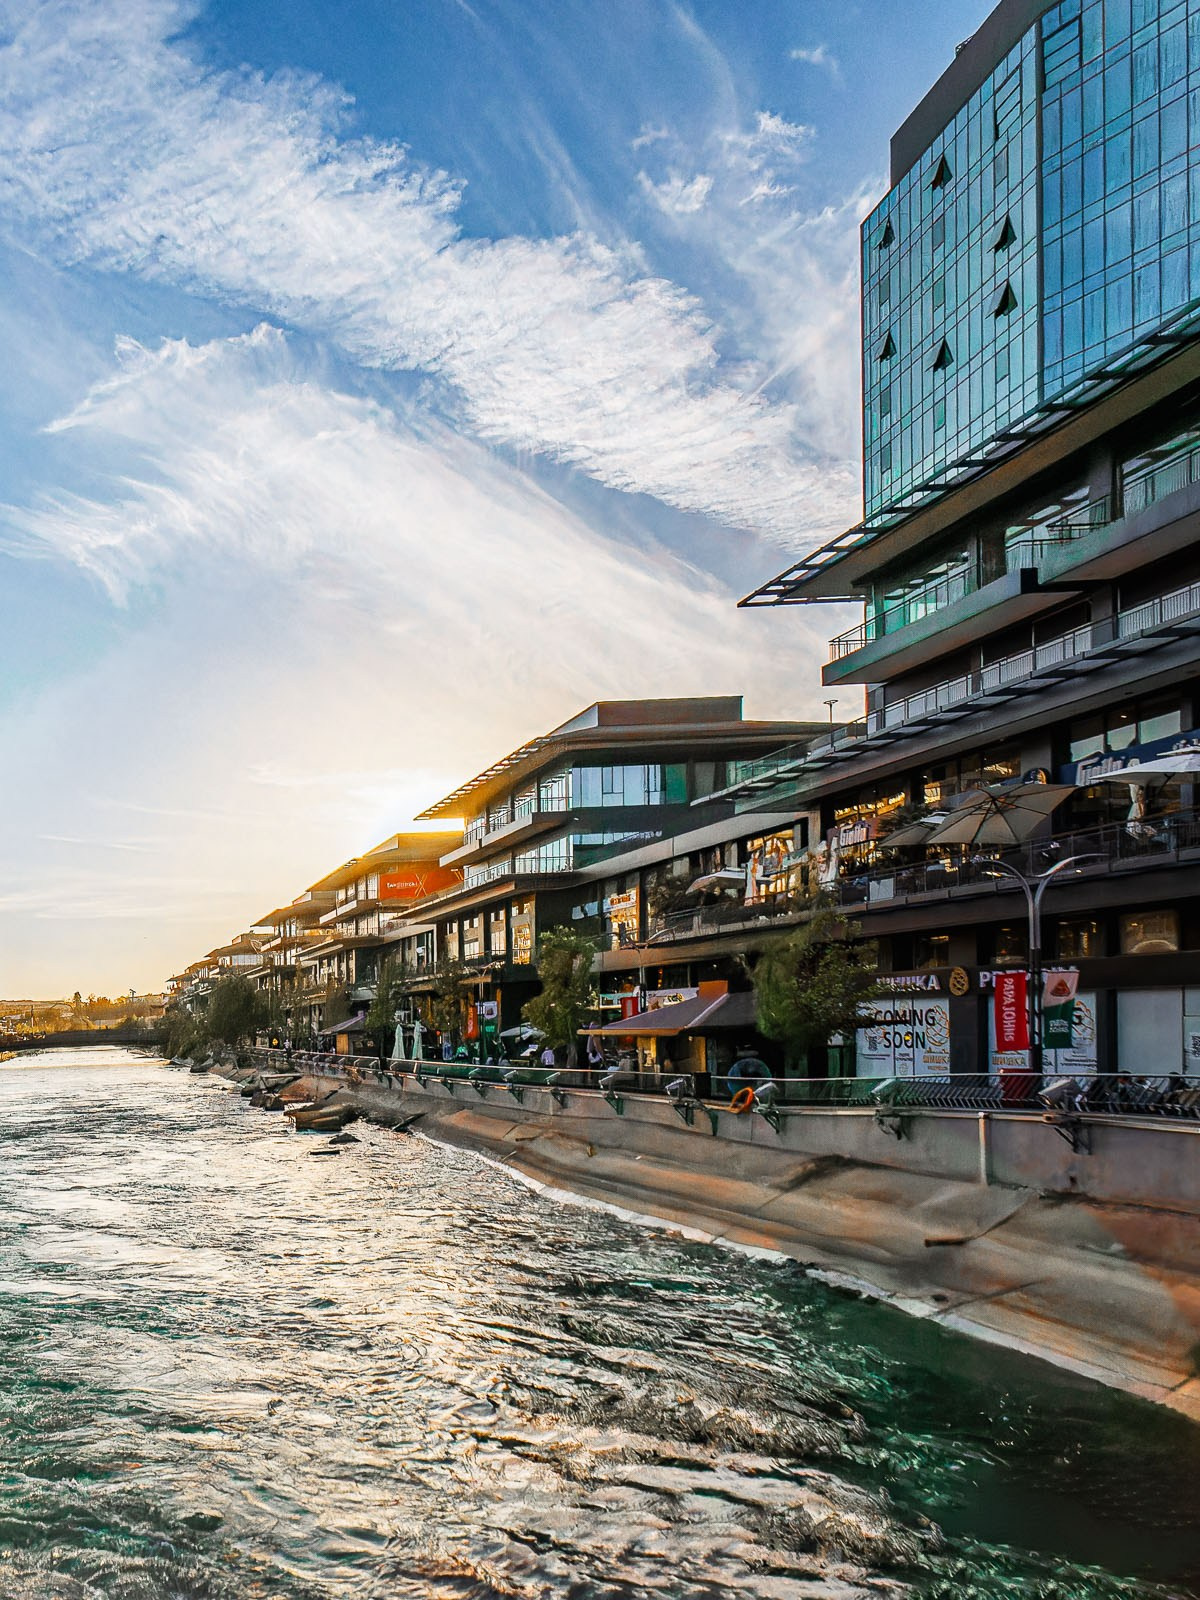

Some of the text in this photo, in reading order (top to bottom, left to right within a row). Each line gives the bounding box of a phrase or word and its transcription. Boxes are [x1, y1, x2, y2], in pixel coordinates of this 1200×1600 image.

[1003, 978, 1016, 1005] PAPA
[875, 1008, 936, 1026] COMING
[883, 1031, 926, 1049] SOON
